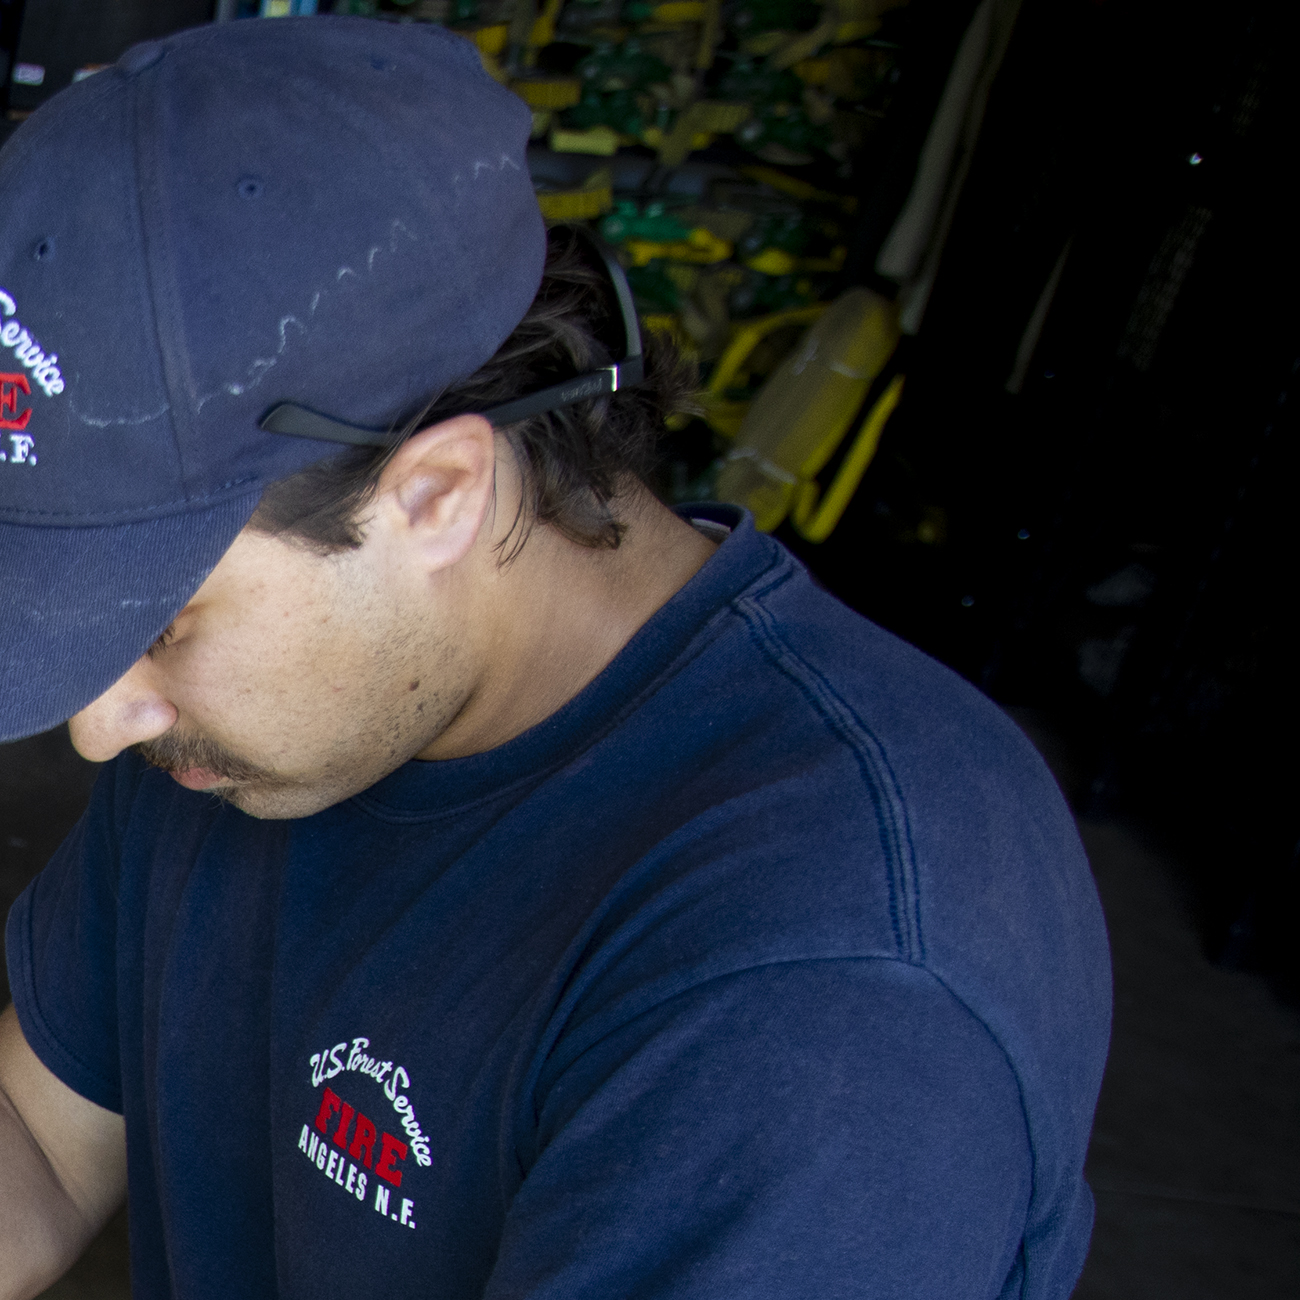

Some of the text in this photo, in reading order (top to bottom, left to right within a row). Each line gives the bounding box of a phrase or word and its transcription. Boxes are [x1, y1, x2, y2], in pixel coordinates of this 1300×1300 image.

[309, 1037, 432, 1167] U.S. Forest Service
[315, 1086, 408, 1187] FIRE
[298, 1123, 368, 1201] ANGELES
